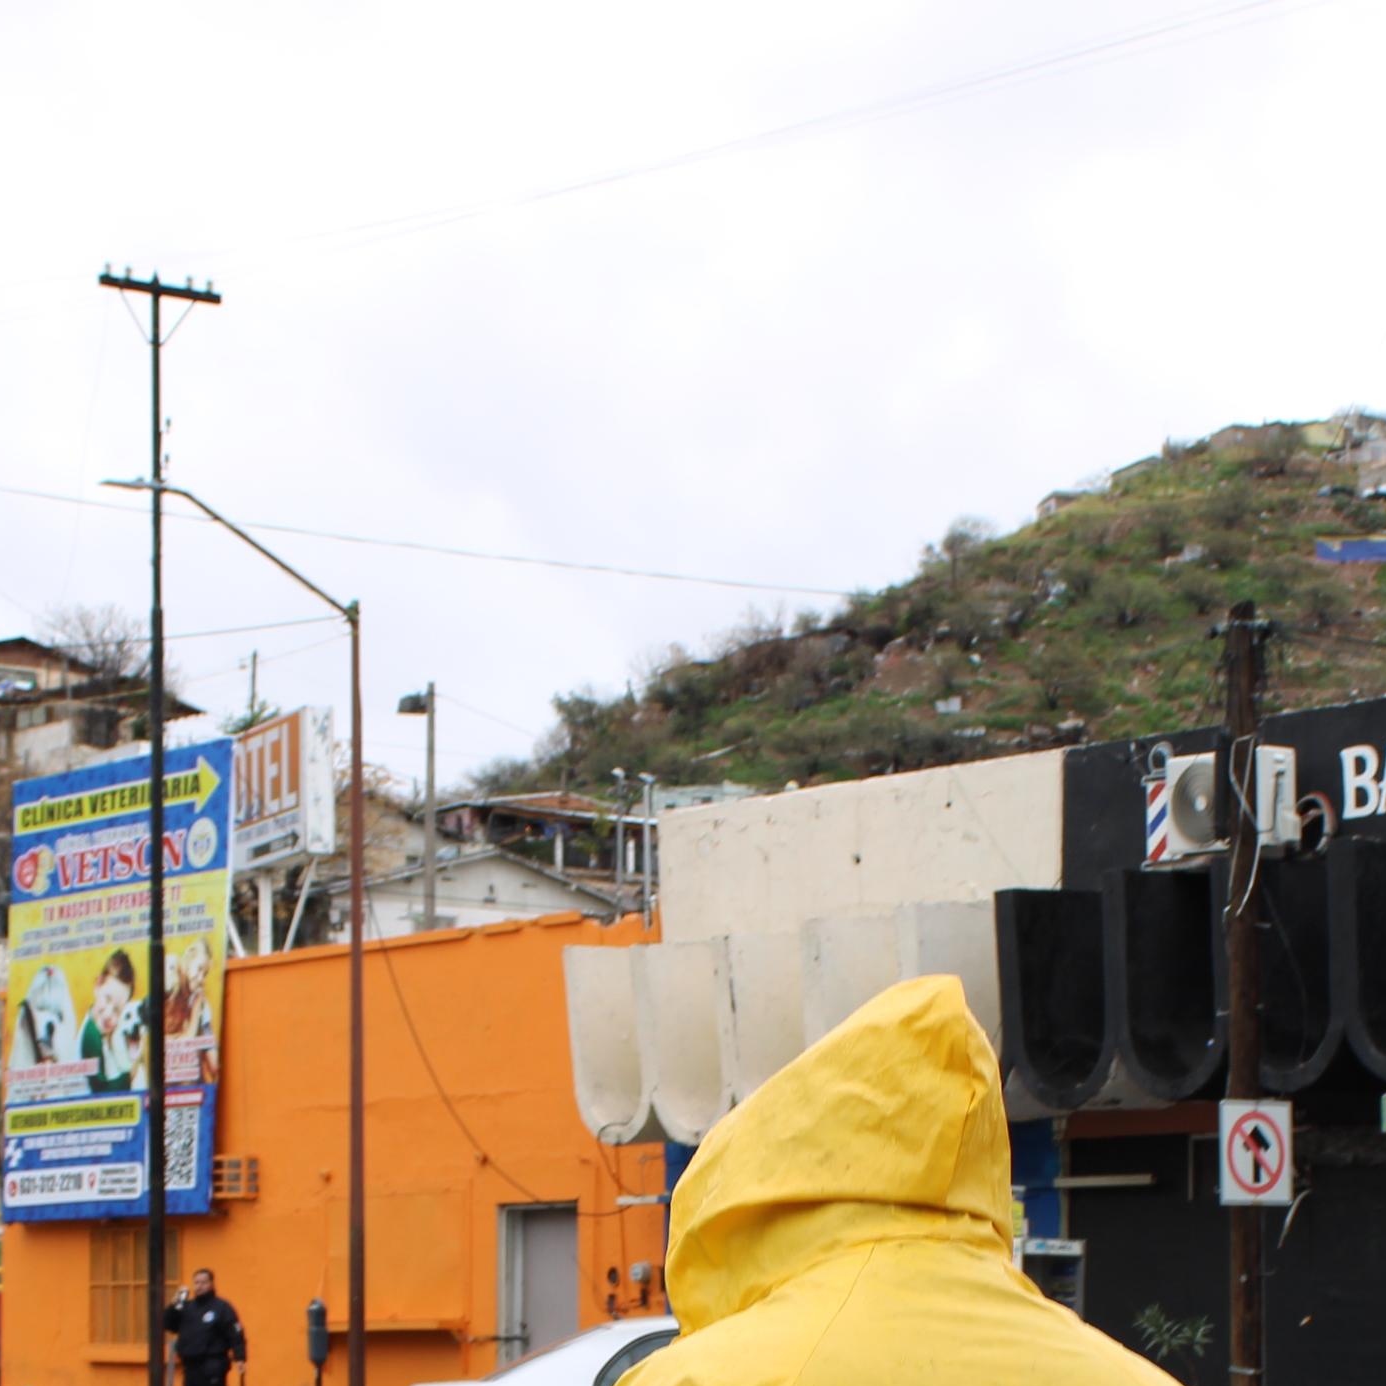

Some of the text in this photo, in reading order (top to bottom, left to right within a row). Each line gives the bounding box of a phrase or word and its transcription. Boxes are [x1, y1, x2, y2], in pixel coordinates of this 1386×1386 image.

[21, 773, 201, 828] CLÍNICA VETERIARIA
[57, 832, 186, 888] VETSON
